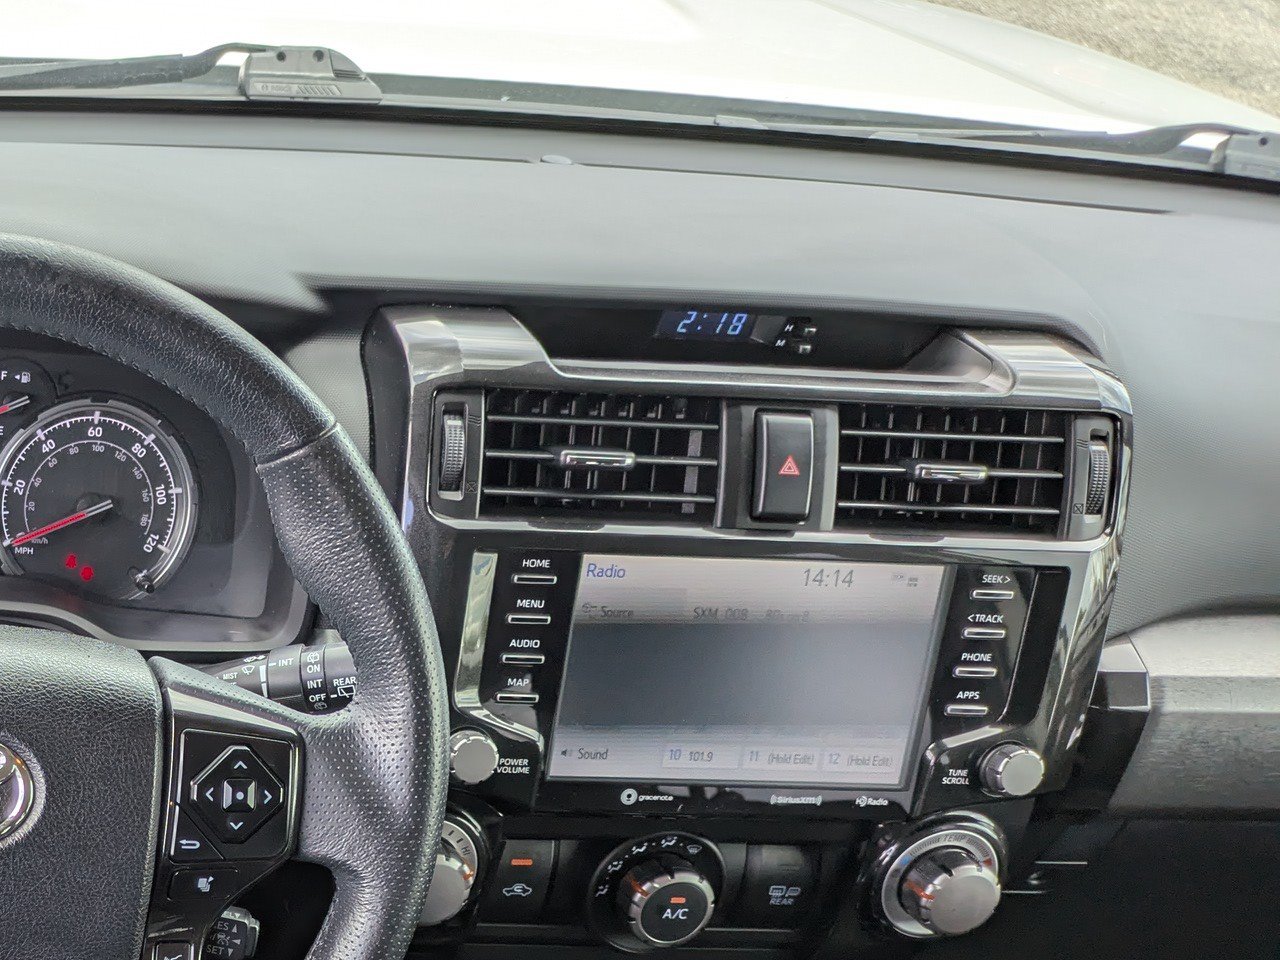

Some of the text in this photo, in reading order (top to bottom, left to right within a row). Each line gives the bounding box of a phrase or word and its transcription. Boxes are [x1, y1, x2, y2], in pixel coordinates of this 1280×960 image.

[676, 310, 748, 335] 2:18
[784, 324, 794, 332] H
[775, 339, 786, 347] M
[0, 371, 8, 381] F
[87, 426, 103, 438] 60
[41, 439, 56, 454] 40
[69, 446, 79, 455] 80
[91, 444, 105, 453] 100
[131, 442, 147, 458] 80
[114, 450, 127, 462] 120
[48, 457, 58, 468] 60
[13, 479, 26, 496] 20
[33, 477, 42, 488] 40
[155, 484, 167, 505] 100
[28, 501, 36, 512] 20
[143, 533, 160, 553] 120
[14, 547, 34, 555] MPH
[522, 558, 551, 569] HOME
[586, 562, 626, 579] Radio
[803, 568, 854, 588] 14:14
[516, 599, 545, 609] MENU
[600, 606, 634, 618] Source
[509, 639, 541, 648] AUDIO
[277, 657, 295, 668] INT
[961, 652, 993, 662] PHONE
[306, 664, 321, 674] ON
[222, 672, 238, 680] MIST
[332, 676, 358, 687] REAR
[306, 678, 323, 690] INT
[507, 677, 530, 687] MAP
[308, 693, 327, 703] OFF
[956, 690, 980, 700] APPS
[577, 748, 610, 760] Sound
[669, 748, 714, 763] 10 101.9
[748, 750, 760, 762] 11
[828, 752, 841, 765] 12
[499, 758, 529, 767] POWER
[496, 766, 530, 775] VOLUME
[948, 769, 969, 777] TUNE
[941, 776, 970, 785] SCROLL
[638, 794, 675, 803] gracenote
[867, 797, 889, 807] Radio
[942, 834, 965, 843] TEMP
[769, 897, 794, 906] REAR
[662, 908, 689, 920] A/C
[216, 921, 229, 931] ES
[206, 944, 224, 956] SET
